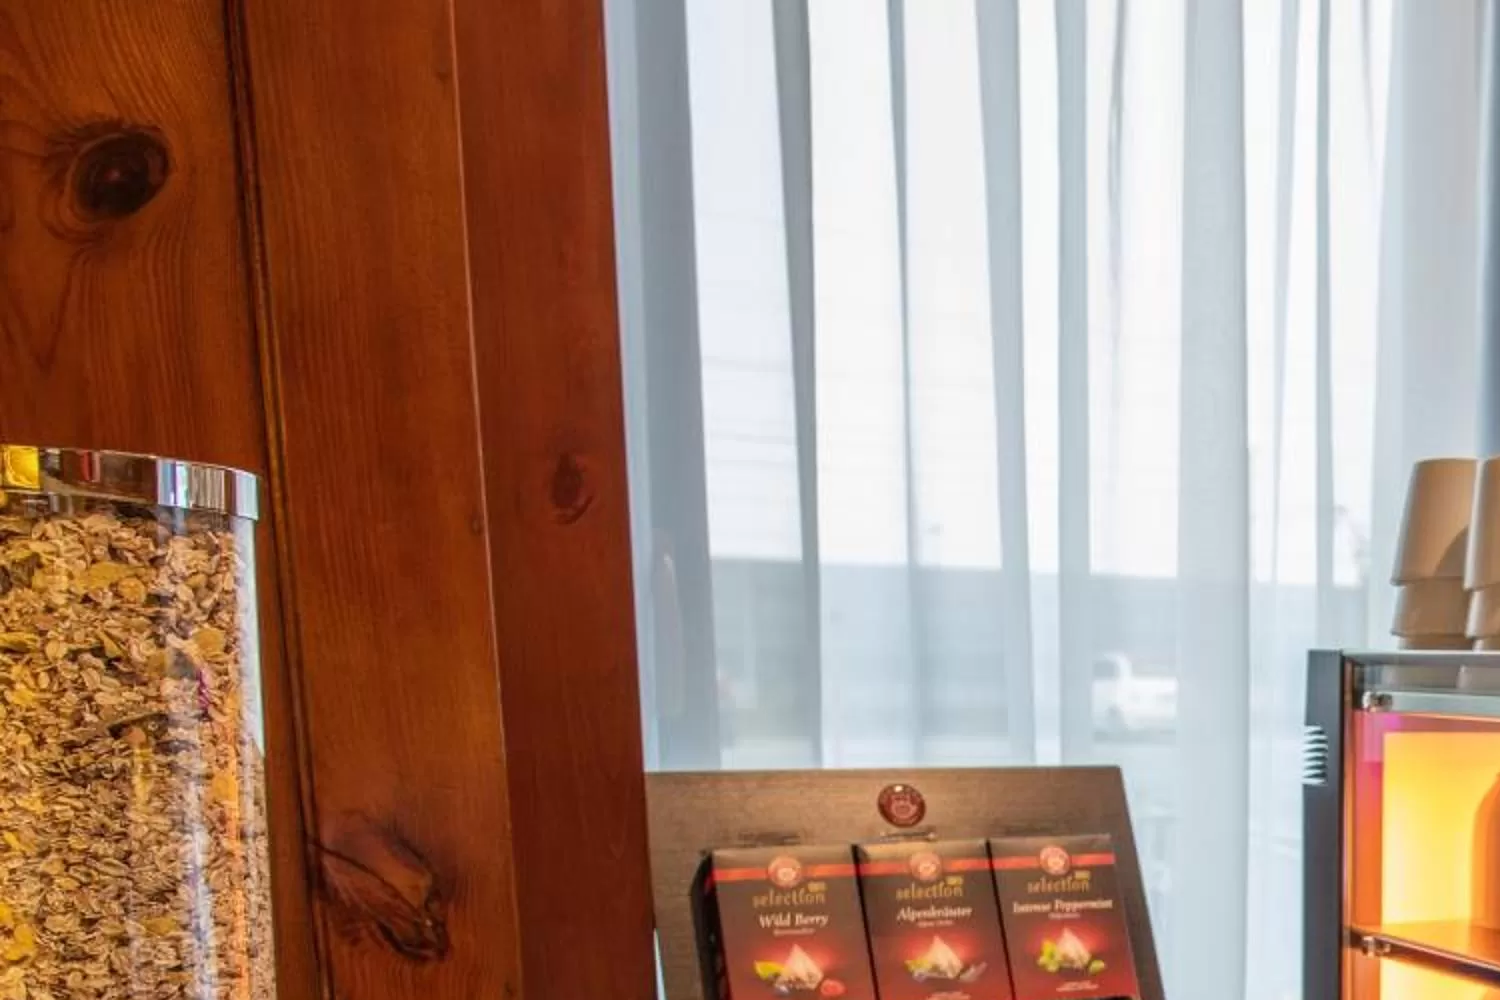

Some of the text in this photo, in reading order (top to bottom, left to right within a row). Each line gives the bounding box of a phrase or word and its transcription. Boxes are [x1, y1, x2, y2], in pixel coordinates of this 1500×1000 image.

[896, 882, 964, 901] selection
[1027, 876, 1090, 894] selection
[752, 887, 826, 909] selection
[759, 912, 829, 929] Wild Berry
